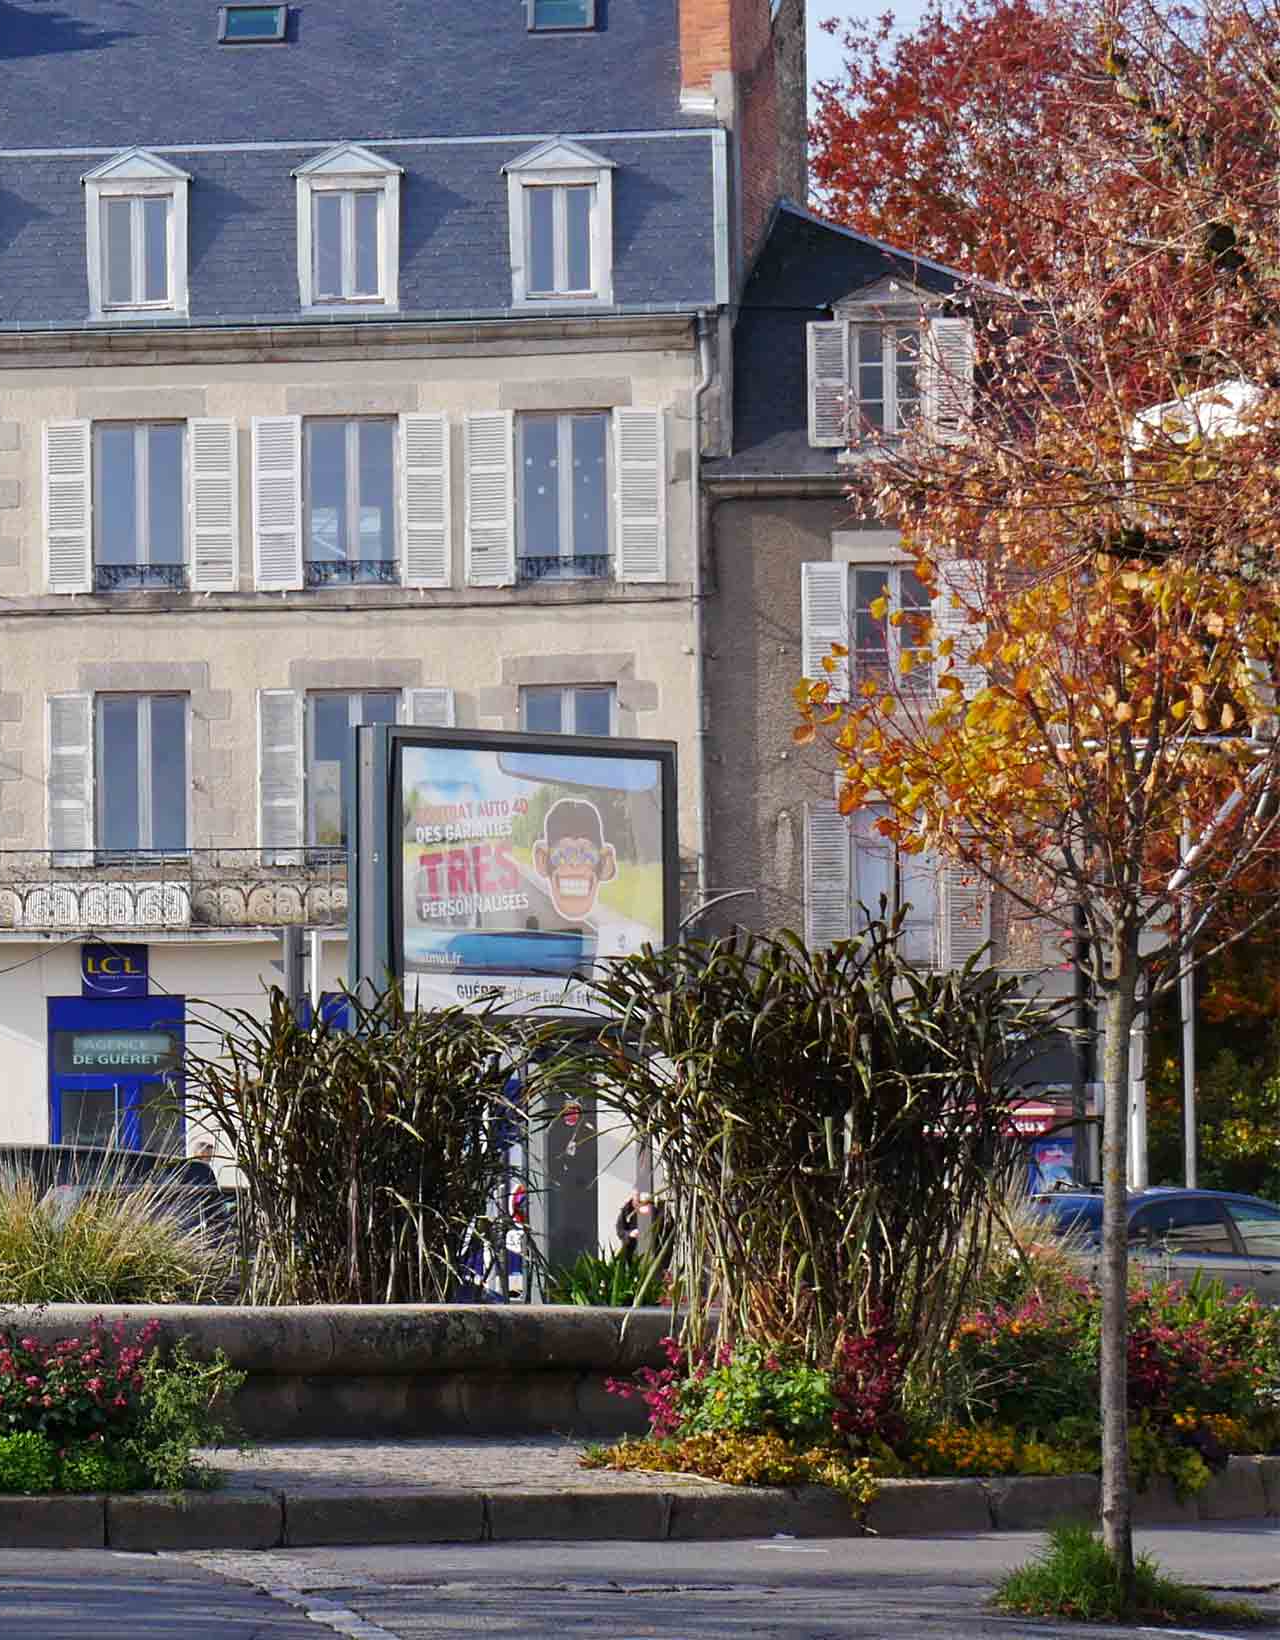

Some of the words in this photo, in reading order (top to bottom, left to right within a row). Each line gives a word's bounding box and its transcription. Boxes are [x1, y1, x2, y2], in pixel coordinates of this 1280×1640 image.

[480, 799, 511, 817] AUTO
[416, 824, 441, 843] DES
[445, 819, 511, 841] GARANTIES
[87, 956, 141, 975] LCL
[72, 1055, 94, 1065] DE
